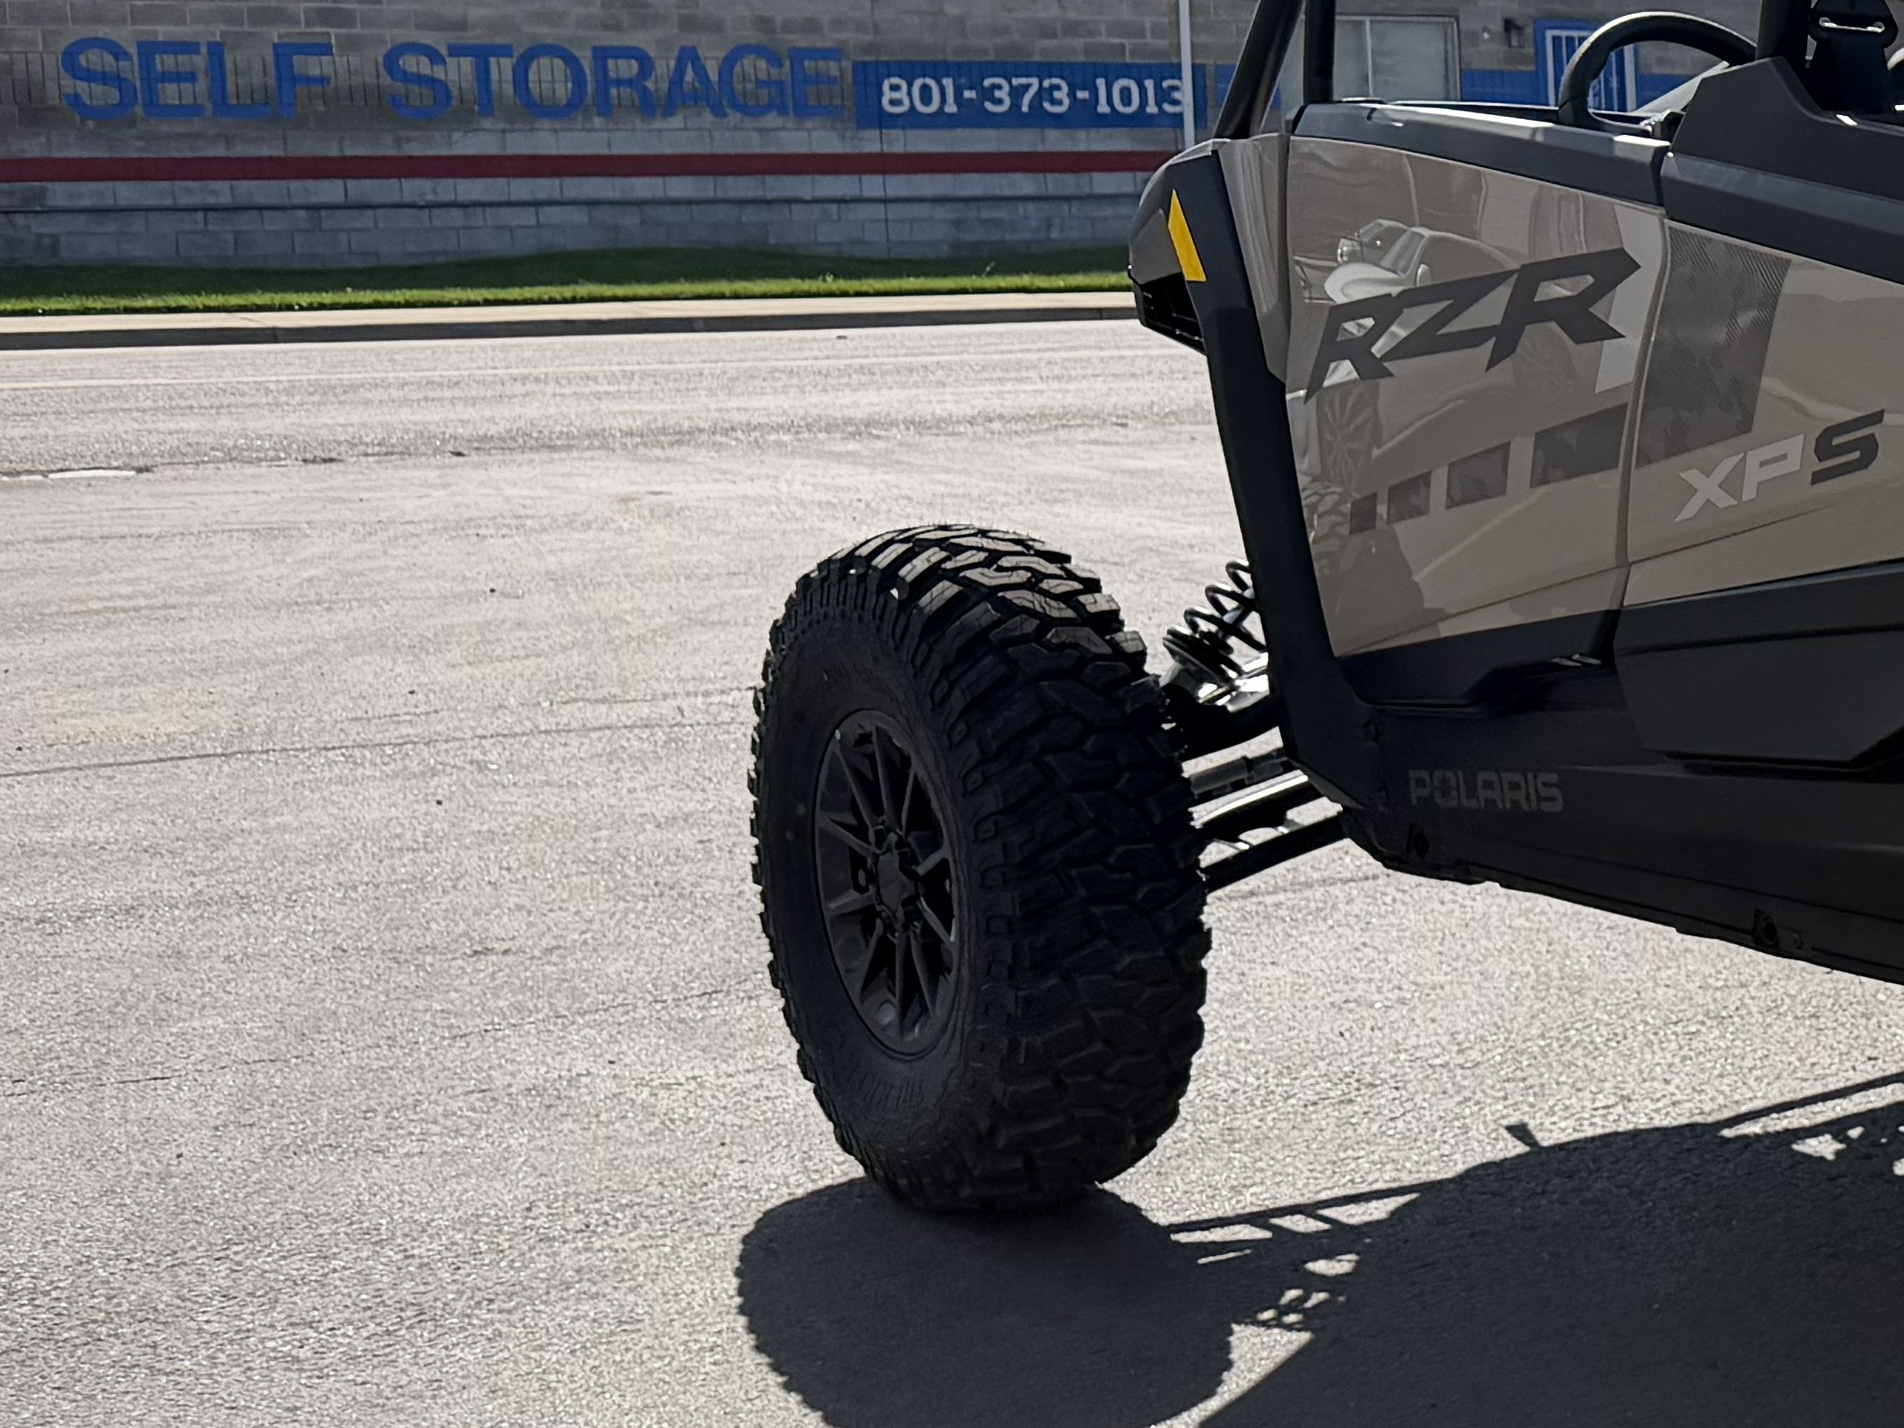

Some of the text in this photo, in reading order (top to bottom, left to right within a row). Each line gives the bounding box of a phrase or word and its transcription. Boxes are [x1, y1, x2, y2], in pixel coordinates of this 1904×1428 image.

[60, 36, 1185, 121] SELF STORAGE 801-373-1013
[1304, 247, 1642, 404] RZR
[1408, 769, 1564, 813] POLARIS
